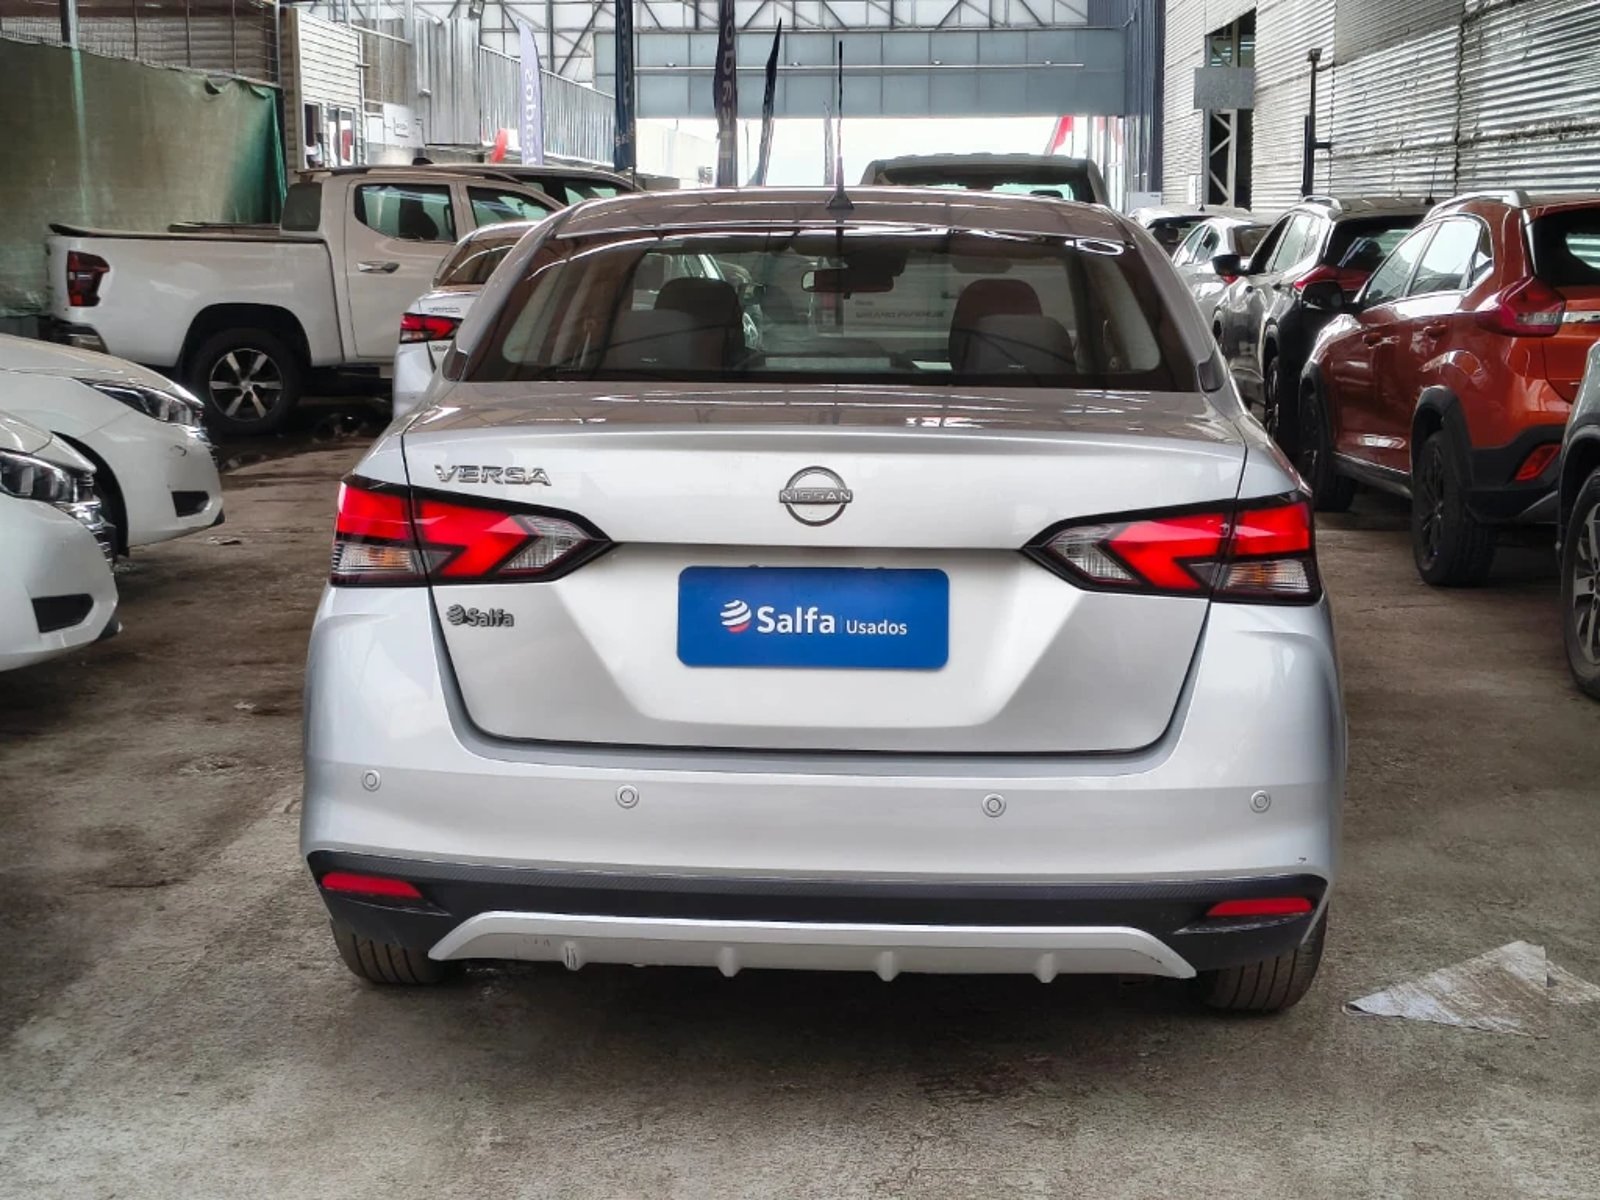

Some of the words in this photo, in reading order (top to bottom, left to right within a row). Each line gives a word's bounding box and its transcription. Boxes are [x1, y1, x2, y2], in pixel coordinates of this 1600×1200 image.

[434, 464, 552, 487] VERSA
[780, 488, 852, 502] NISSAN
[466, 607, 515, 628] Salfa
[756, 606, 836, 634] Salfa
[845, 619, 908, 636] Usados
